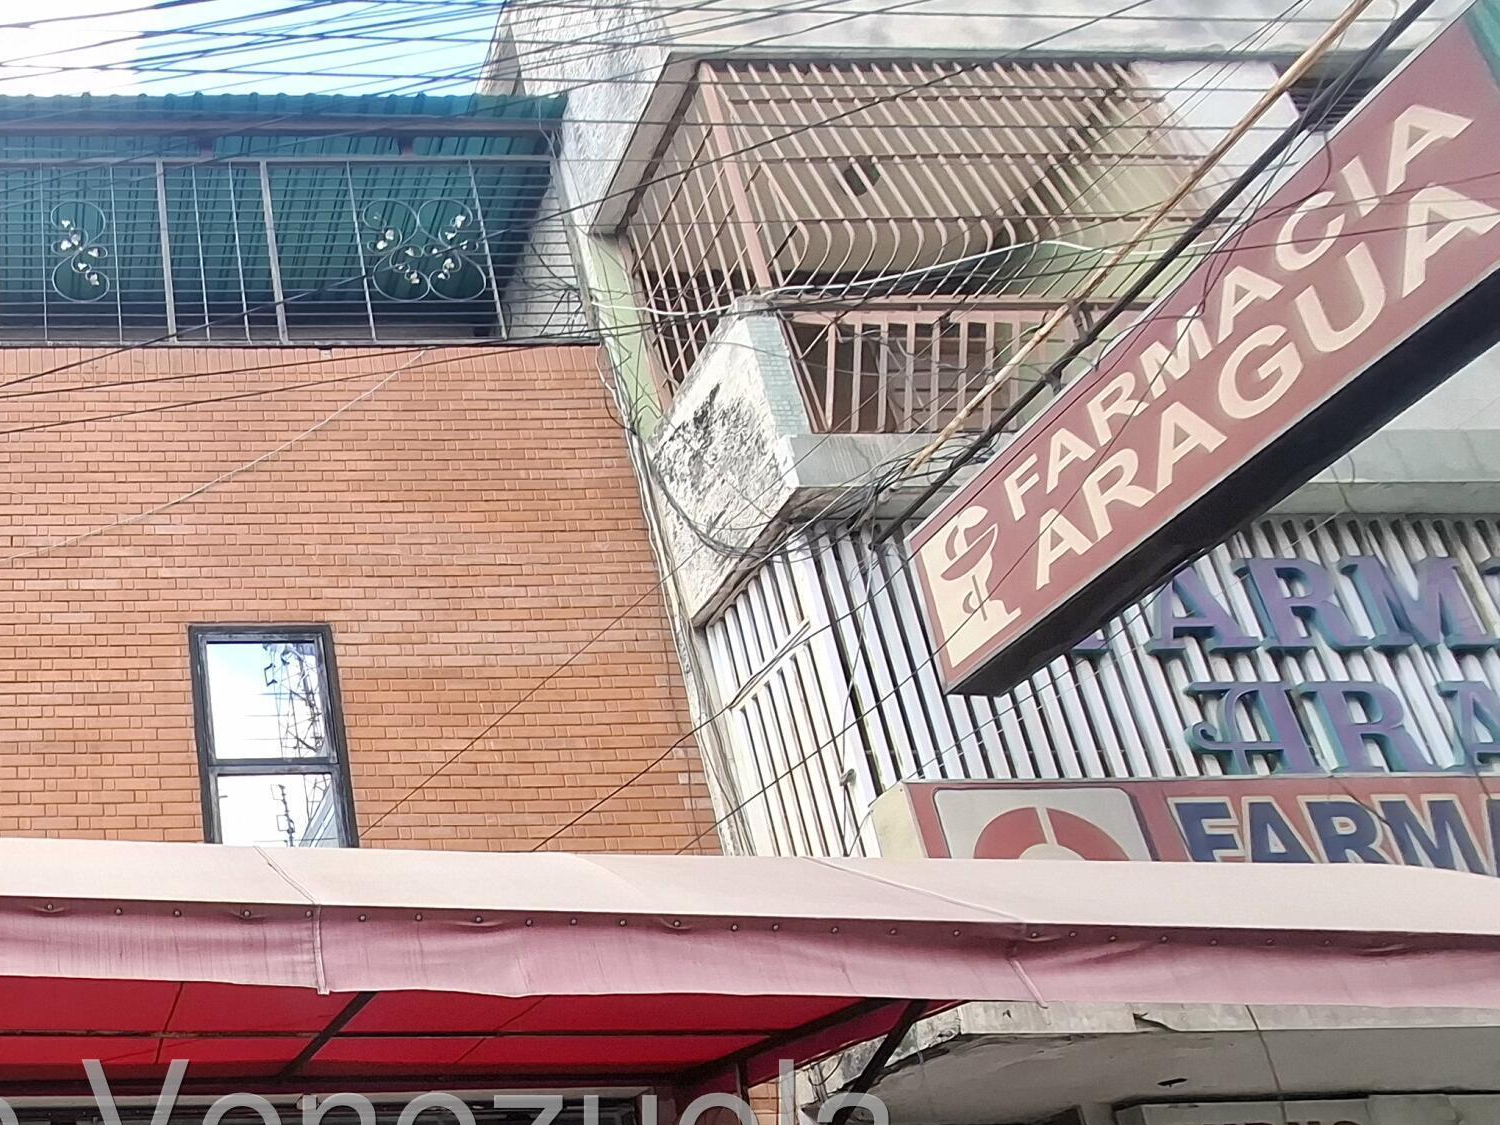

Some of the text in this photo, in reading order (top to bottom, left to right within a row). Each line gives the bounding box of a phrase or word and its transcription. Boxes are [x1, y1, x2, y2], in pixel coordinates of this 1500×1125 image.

[1002, 103, 1475, 523] FARMACIA
[1035, 183, 1500, 589] ARAGUA
[1167, 794, 1500, 877] FARM
